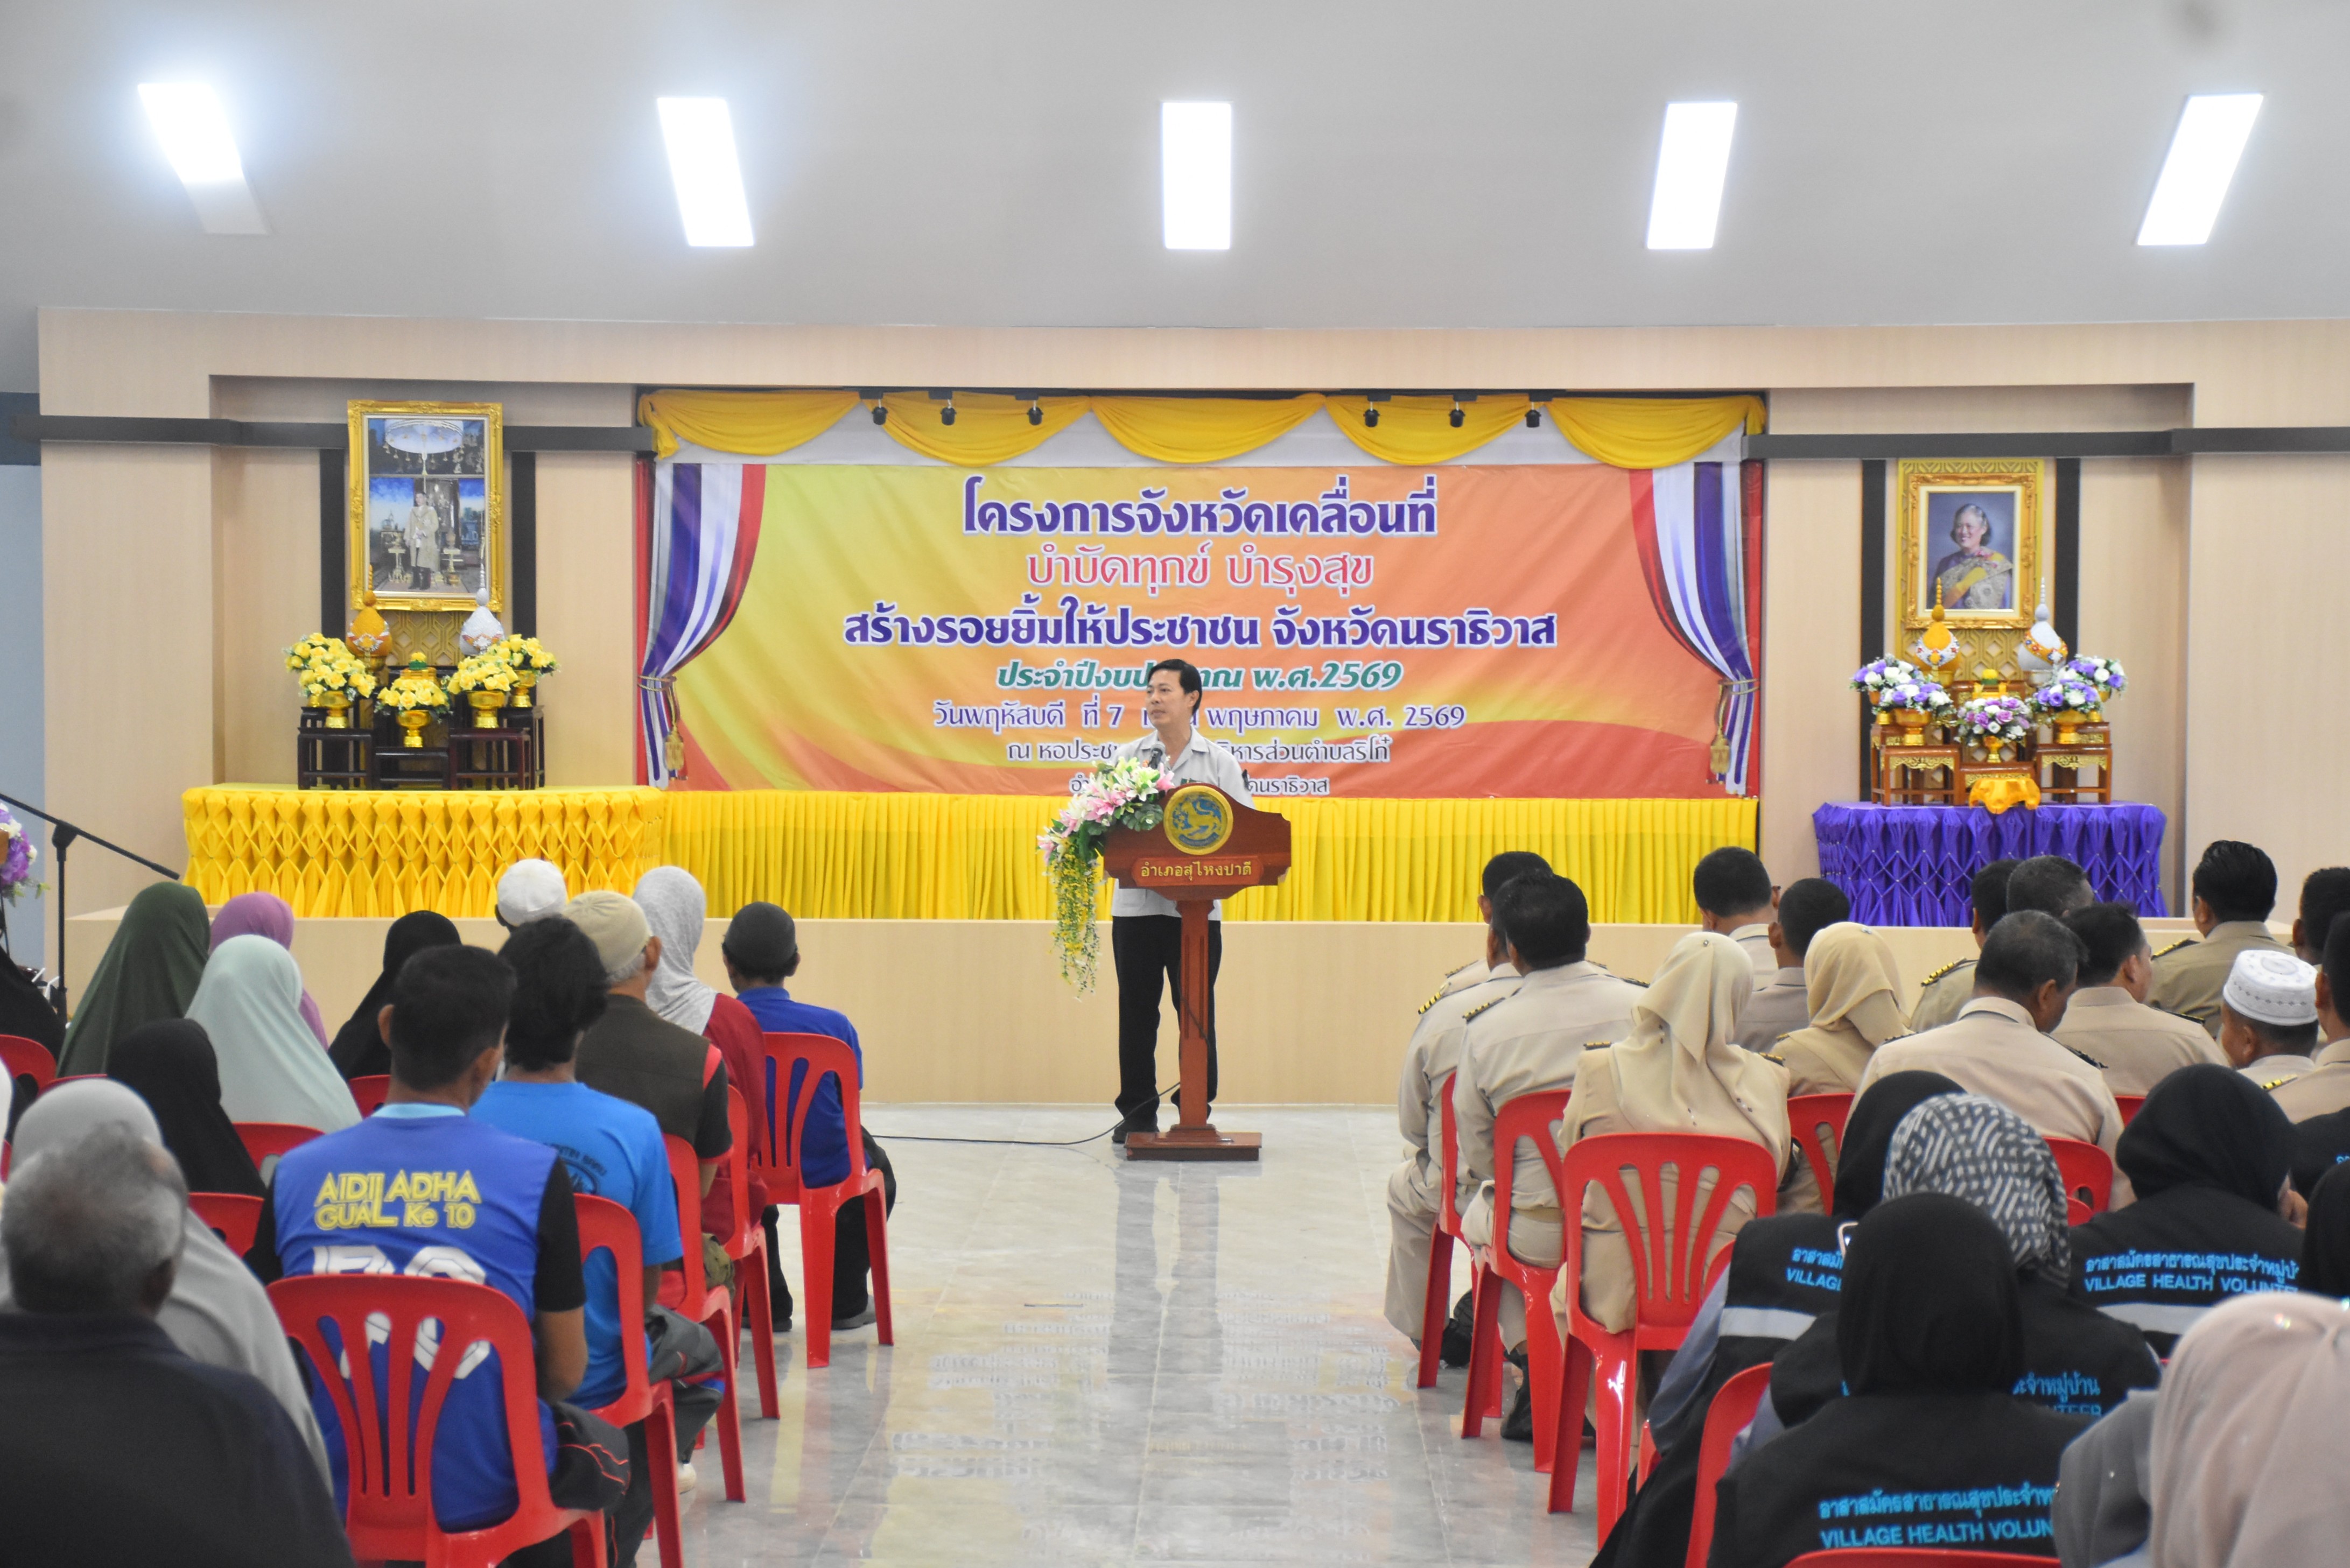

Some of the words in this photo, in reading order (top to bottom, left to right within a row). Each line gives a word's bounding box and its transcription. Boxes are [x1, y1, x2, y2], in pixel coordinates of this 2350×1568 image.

[964, 476, 1436, 533] โครงการจังหวัดเคลื่อนที่
[1029, 542, 1212, 594] บำบัดทุกข์
[1228, 544, 1372, 594] บำรุงสุข
[845, 594, 1259, 645] สร้างรอยยิ้มให้ประชาชน
[1273, 608, 1556, 645] จังหวัดนราธิวาส
[998, 662, 1241, 687] ประจำปีงบปาณ
[1254, 663, 1401, 688] พ.ศ.2569
[936, 701, 1064, 731] วันพฤหัสบดี
[1084, 696, 1098, 725] ที่
[1107, 707, 1122, 725] 7
[1208, 709, 1317, 732] พฤษภาคม
[1338, 708, 1391, 726] พ.ศ.
[1406, 707, 1464, 725] 2569
[1141, 861, 1251, 881] อำเภอสุไหงปาดี
[383, 1169, 482, 1204] ADHA
[404, 1203, 438, 1227] Ke
[443, 1203, 475, 1229] 10
[2085, 1274, 2146, 1292] VILLAGE
[2153, 1274, 2214, 1291] HEALTH
[1821, 1525, 1904, 1548] VILLAGE
[1907, 1522, 1985, 1544] HEALTH
[1988, 1519, 2053, 1541] VOLUN
